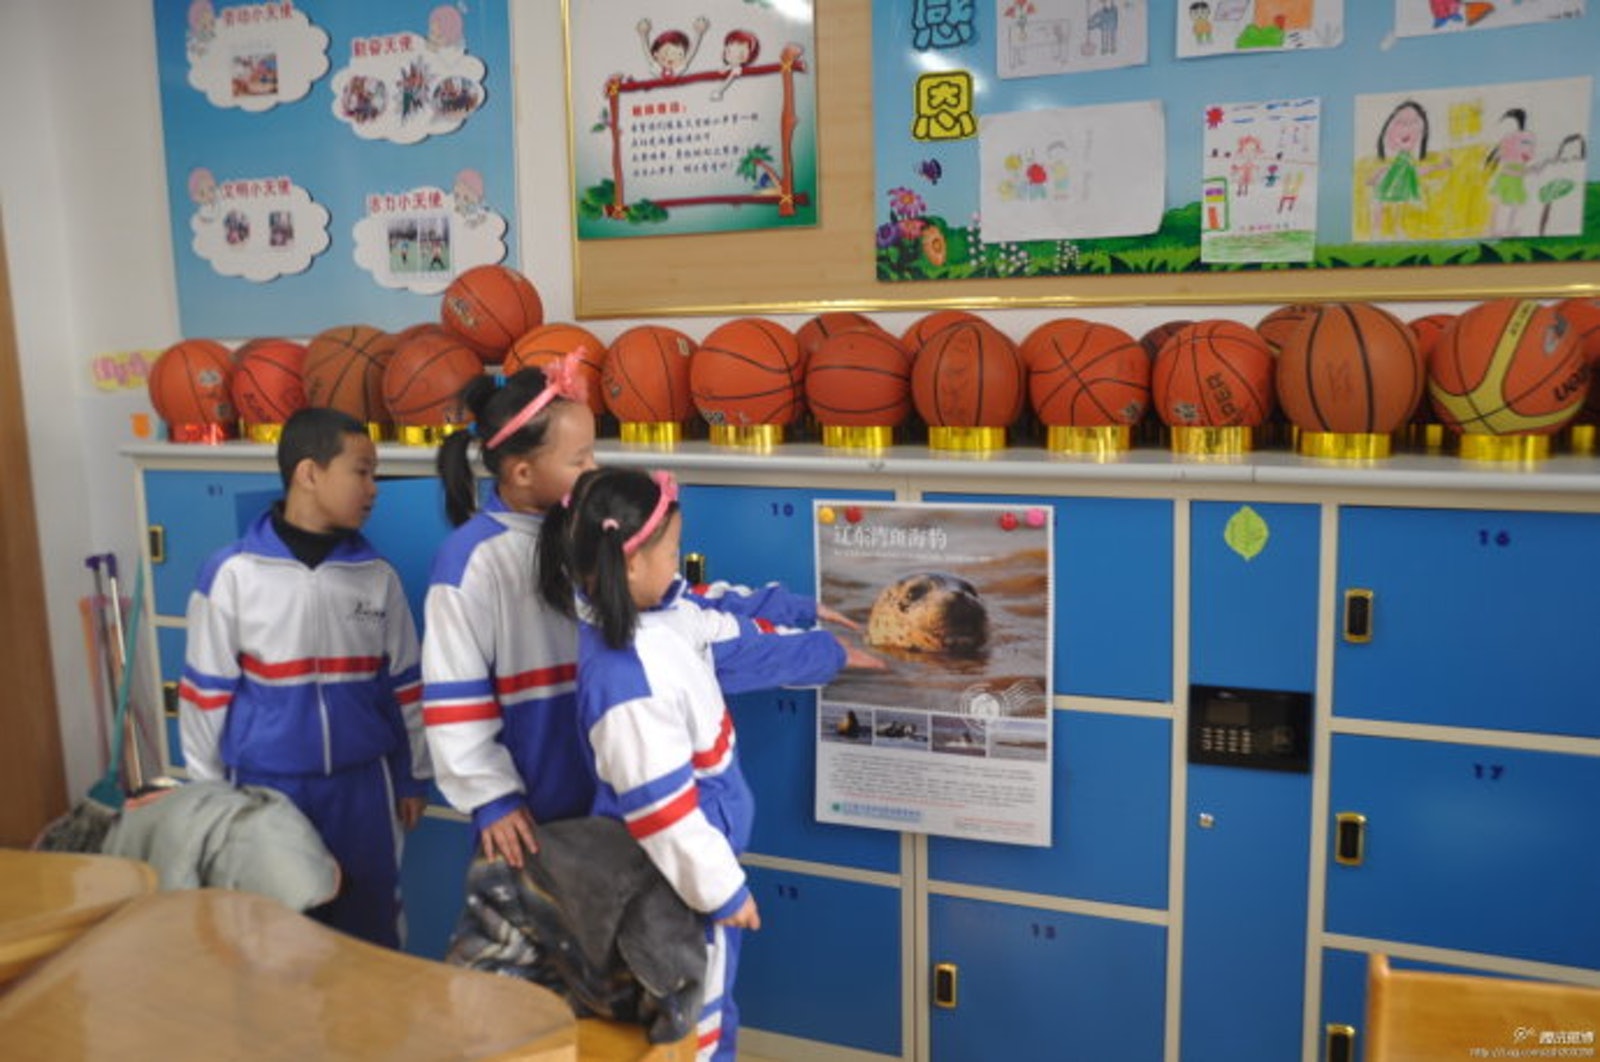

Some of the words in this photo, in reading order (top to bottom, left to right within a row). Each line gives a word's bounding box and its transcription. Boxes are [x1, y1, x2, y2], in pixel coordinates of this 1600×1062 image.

[771, 502, 794, 517] 10
[1479, 529, 1511, 546] 16
[1474, 764, 1504, 780] 17
